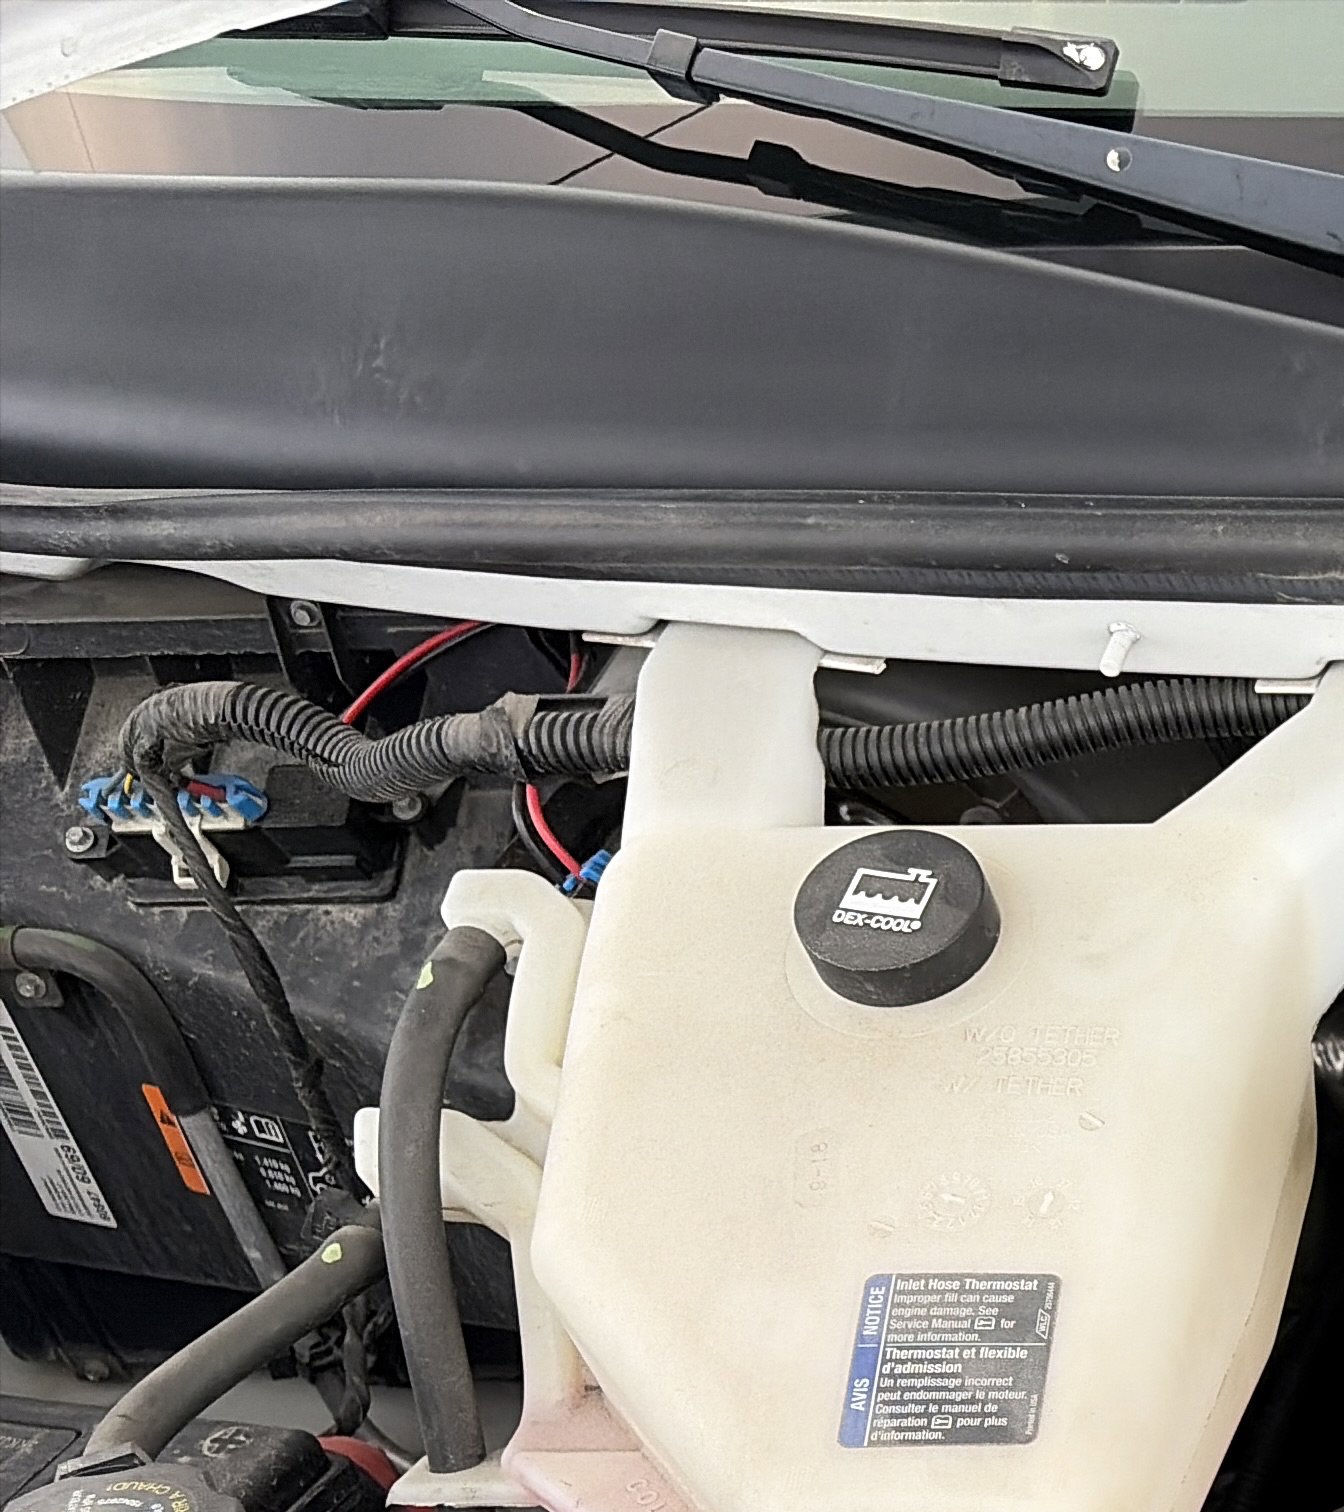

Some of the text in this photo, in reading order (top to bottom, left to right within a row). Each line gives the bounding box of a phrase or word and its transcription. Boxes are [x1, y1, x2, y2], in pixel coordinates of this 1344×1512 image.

[1031, 1025, 1122, 1047] TETHER
[995, 1075, 1085, 1097] TETHER
[896, 1278, 1038, 1291] Inlet Hose Thermostat
[893, 1292, 1015, 1305] Improper fill can cause
[862, 1286, 886, 1336] NOTICE
[891, 1305, 999, 1318] engine damage. See
[889, 1318, 1016, 1330] Service Manual for
[1038, 1315, 1048, 1332] WLC
[887, 1332, 982, 1343] more information.
[885, 1347, 1029, 1360] Thermostat et flexible
[881, 1362, 962, 1374] d'admission
[879, 1376, 1014, 1389] Un remplissage incorrect
[850, 1378, 870, 1412] AVIS
[876, 1390, 1028, 1402] peut endommager le moteur.
[875, 1403, 999, 1414] Consulter le manuel de
[872, 1415, 1009, 1428] réparation pour plus
[870, 1429, 946, 1442] d'information.
[106, 1481, 171, 1496] CHAUD!
